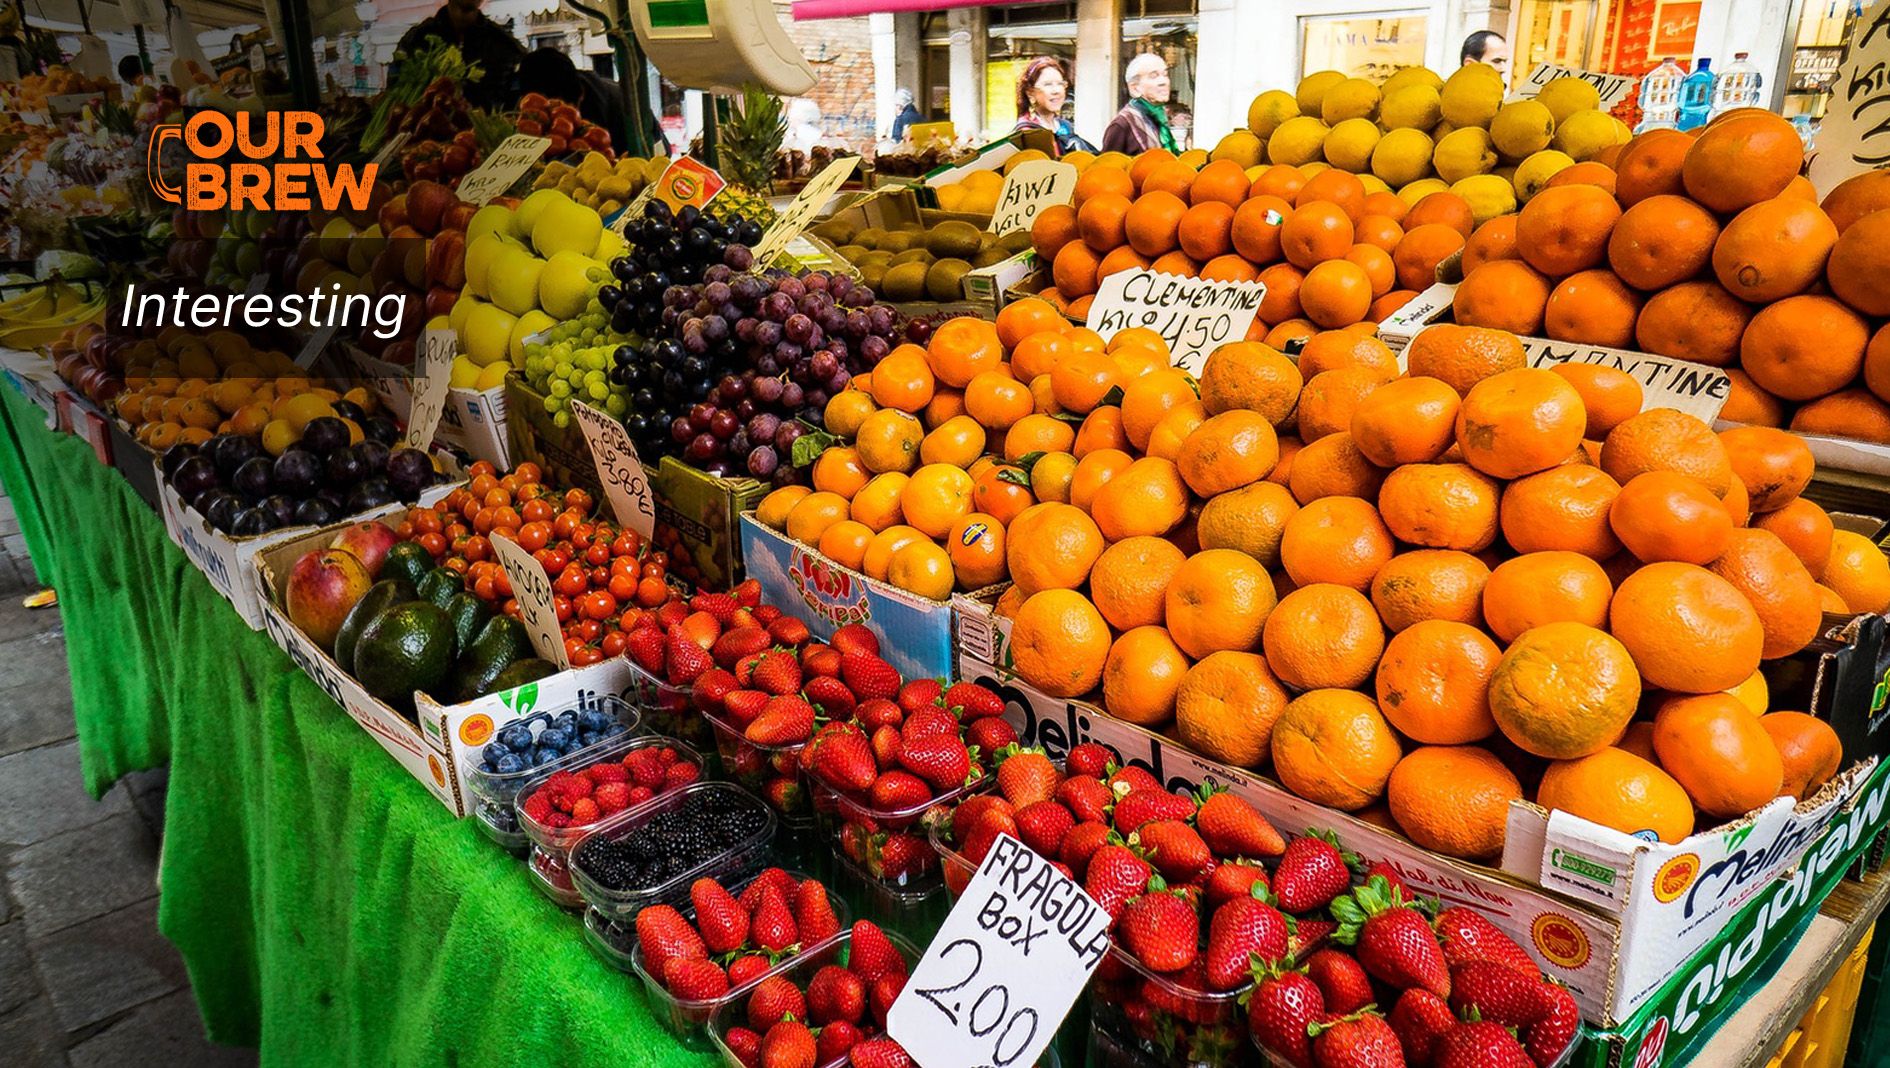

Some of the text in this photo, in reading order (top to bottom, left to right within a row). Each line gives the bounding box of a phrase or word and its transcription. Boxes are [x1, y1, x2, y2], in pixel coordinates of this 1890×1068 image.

[1001, 173, 1057, 211] KIWI
[1123, 274, 1264, 311] CLEMENTINE
[983, 835, 1111, 971] FRAGOLA
[1436, 871, 1464, 894] di
[1461, 880, 1515, 907] Non
[914, 938, 1039, 1067] 2.00
